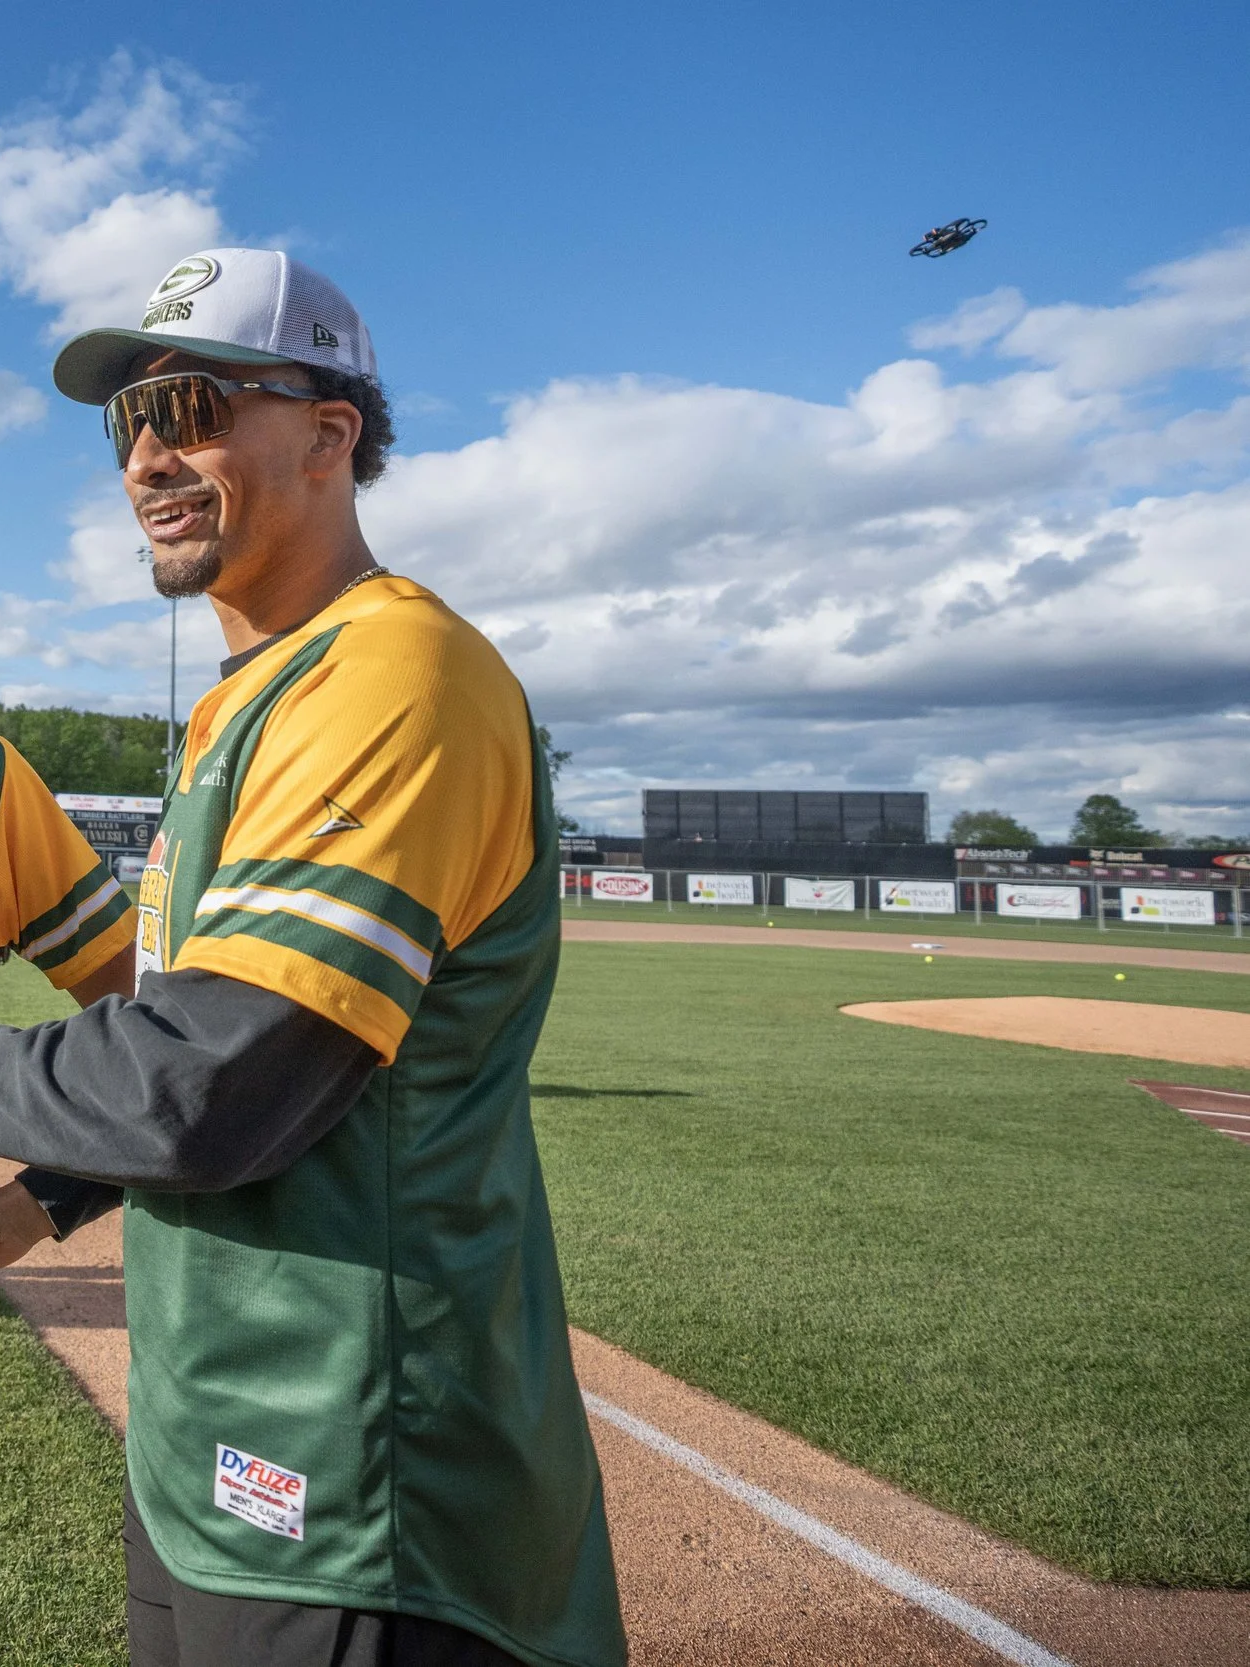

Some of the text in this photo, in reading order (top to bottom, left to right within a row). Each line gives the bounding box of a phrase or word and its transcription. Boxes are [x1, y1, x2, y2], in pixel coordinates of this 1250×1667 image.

[599, 879, 647, 893] COUSINS
[705, 880, 749, 890] network
[717, 889, 750, 900] health
[899, 887, 949, 898] network
[913, 897, 951, 909] health
[1147, 896, 1206, 908] network
[1163, 906, 1206, 919] health
[221, 1448, 301, 1496] DyFuze
